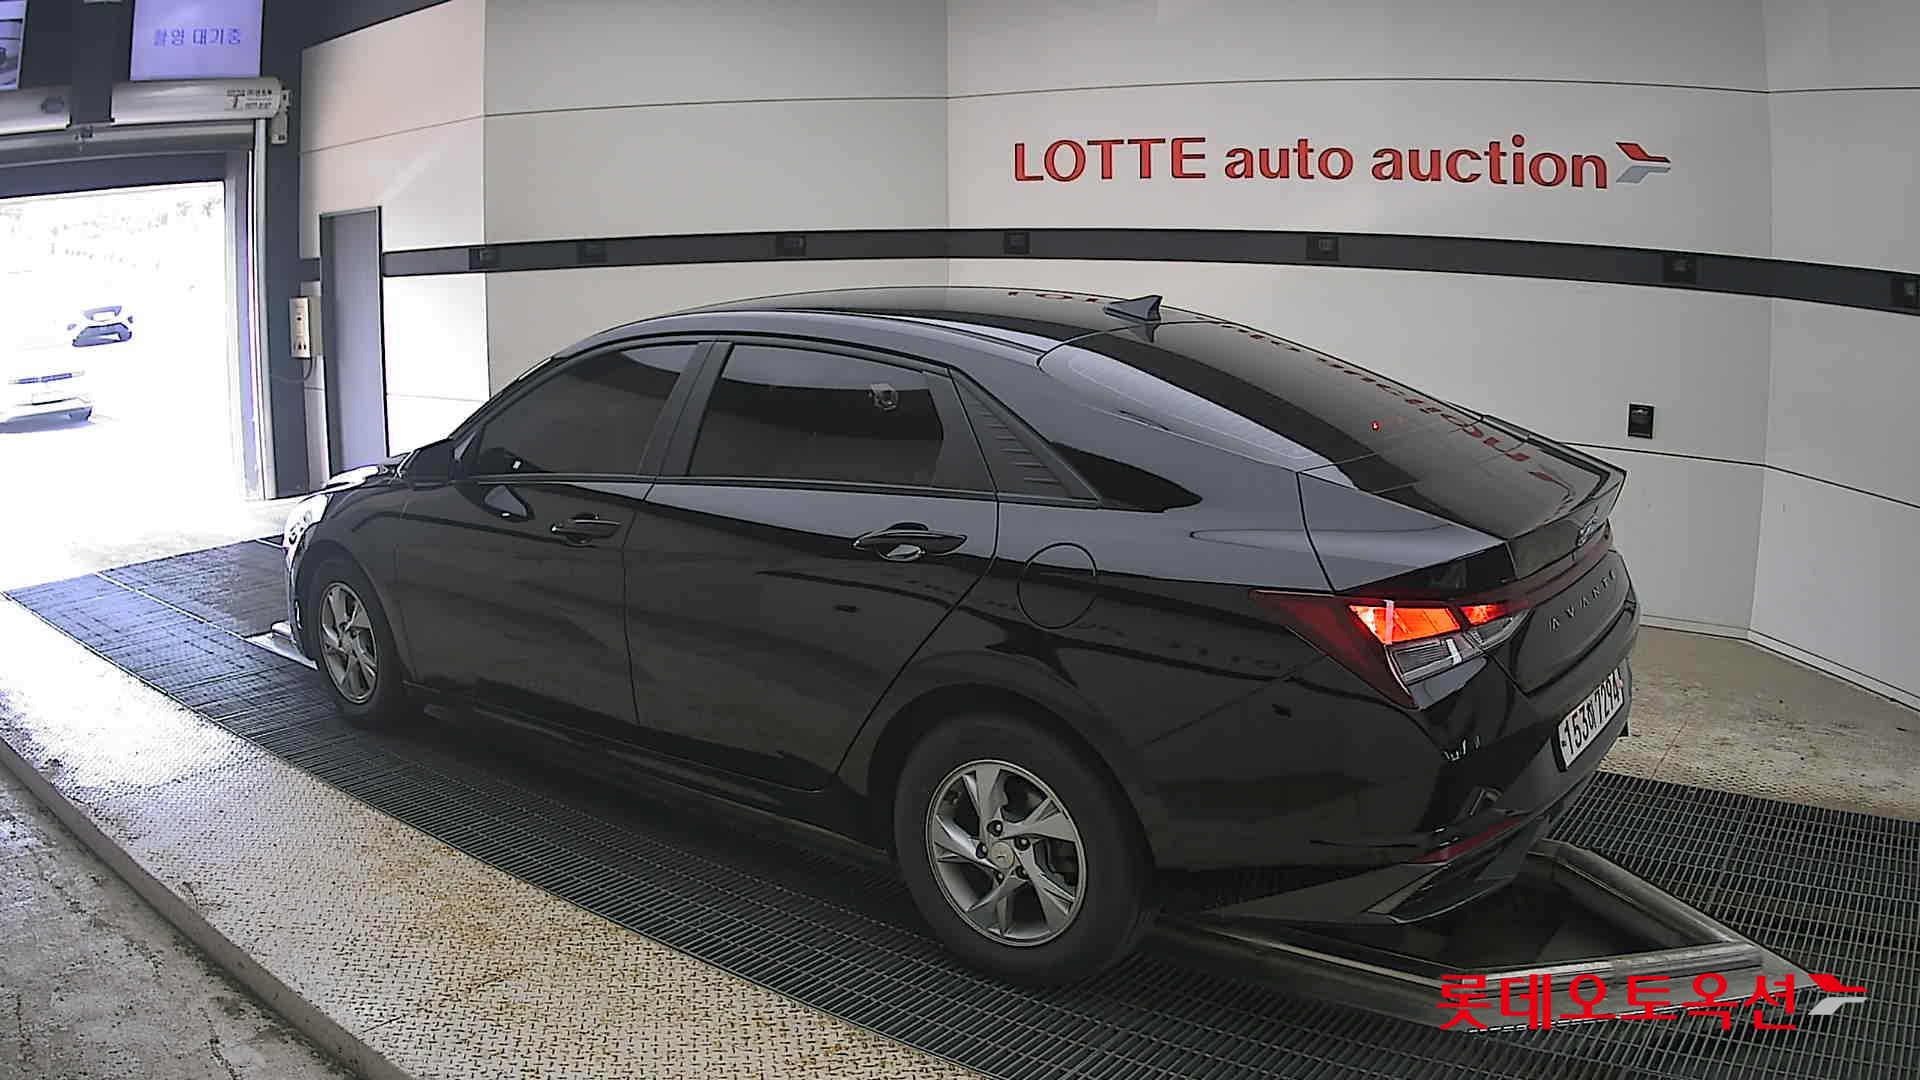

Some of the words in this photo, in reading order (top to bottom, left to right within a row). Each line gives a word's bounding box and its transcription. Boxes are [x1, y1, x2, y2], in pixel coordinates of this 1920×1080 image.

[192, 27, 241, 46] 대기중
[1013, 137, 1206, 182] LOTTE
[1224, 138, 1354, 180] auto
[1371, 134, 1608, 189] auction
